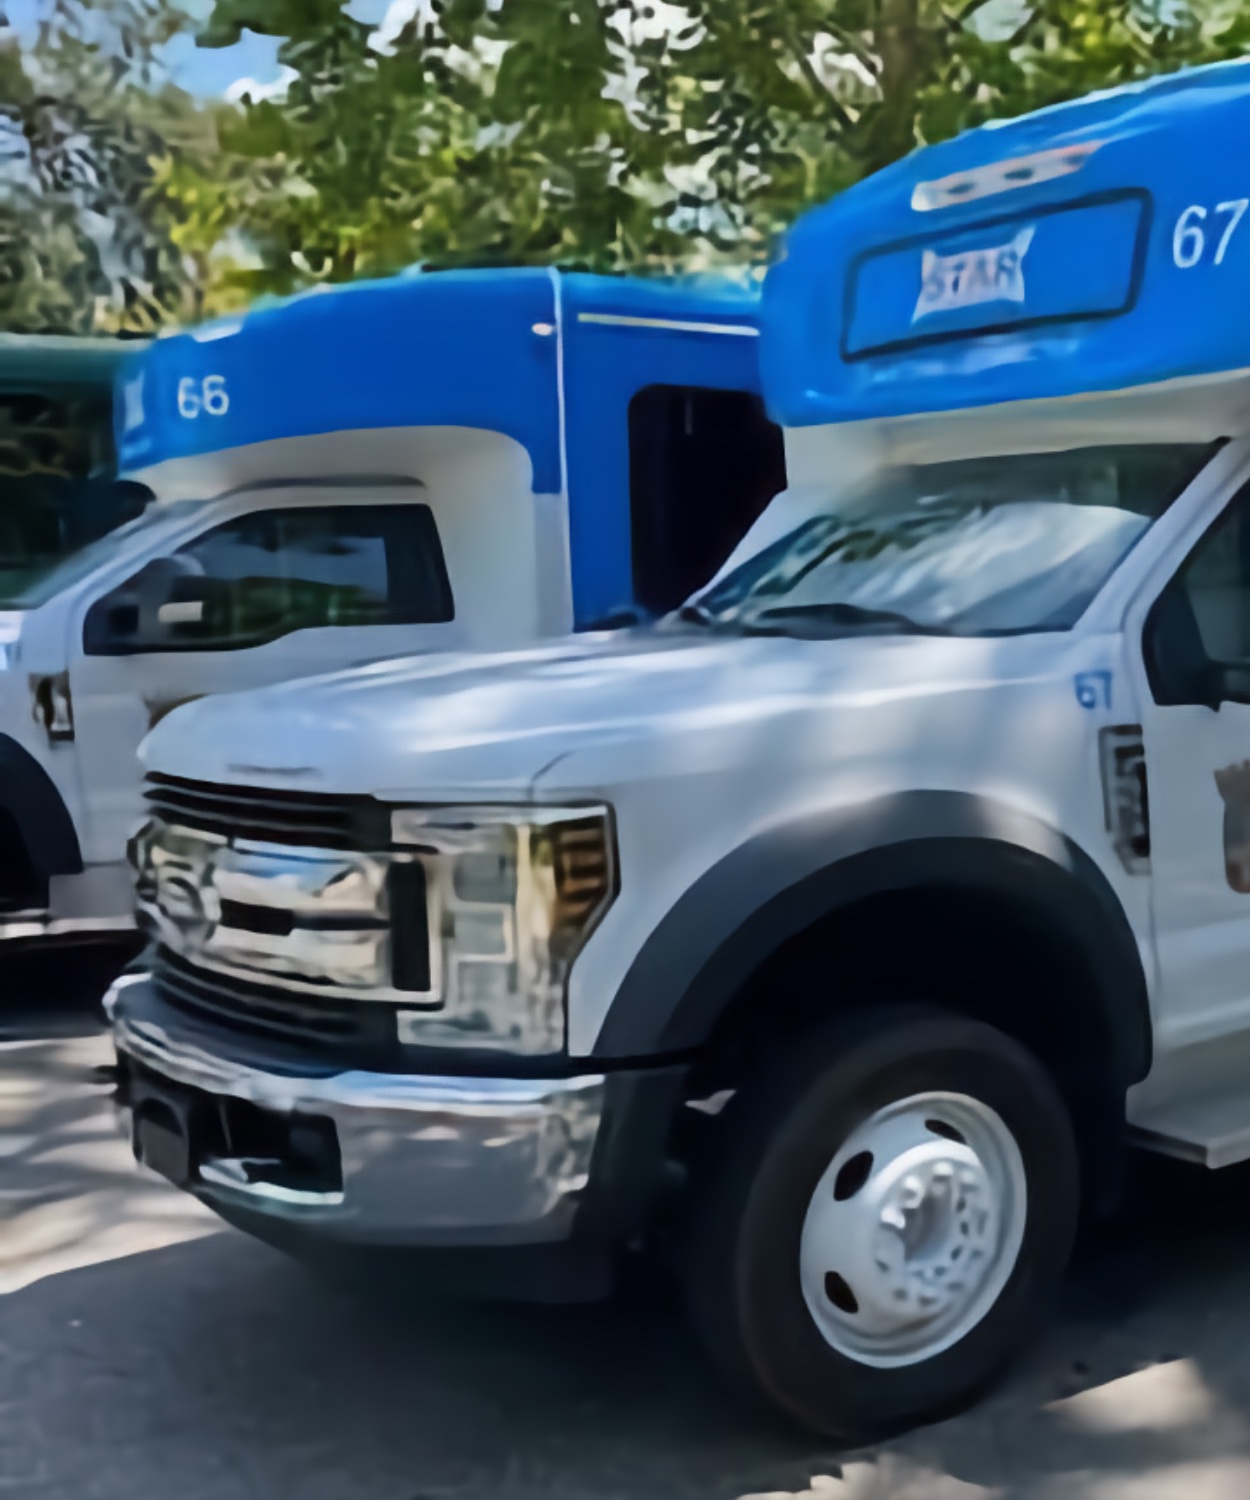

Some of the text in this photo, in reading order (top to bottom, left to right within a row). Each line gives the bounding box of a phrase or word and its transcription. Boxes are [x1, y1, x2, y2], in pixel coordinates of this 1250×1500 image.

[1173, 199, 1250, 269] 67
[177, 374, 230, 419] 66
[1074, 670, 1112, 709] 67
